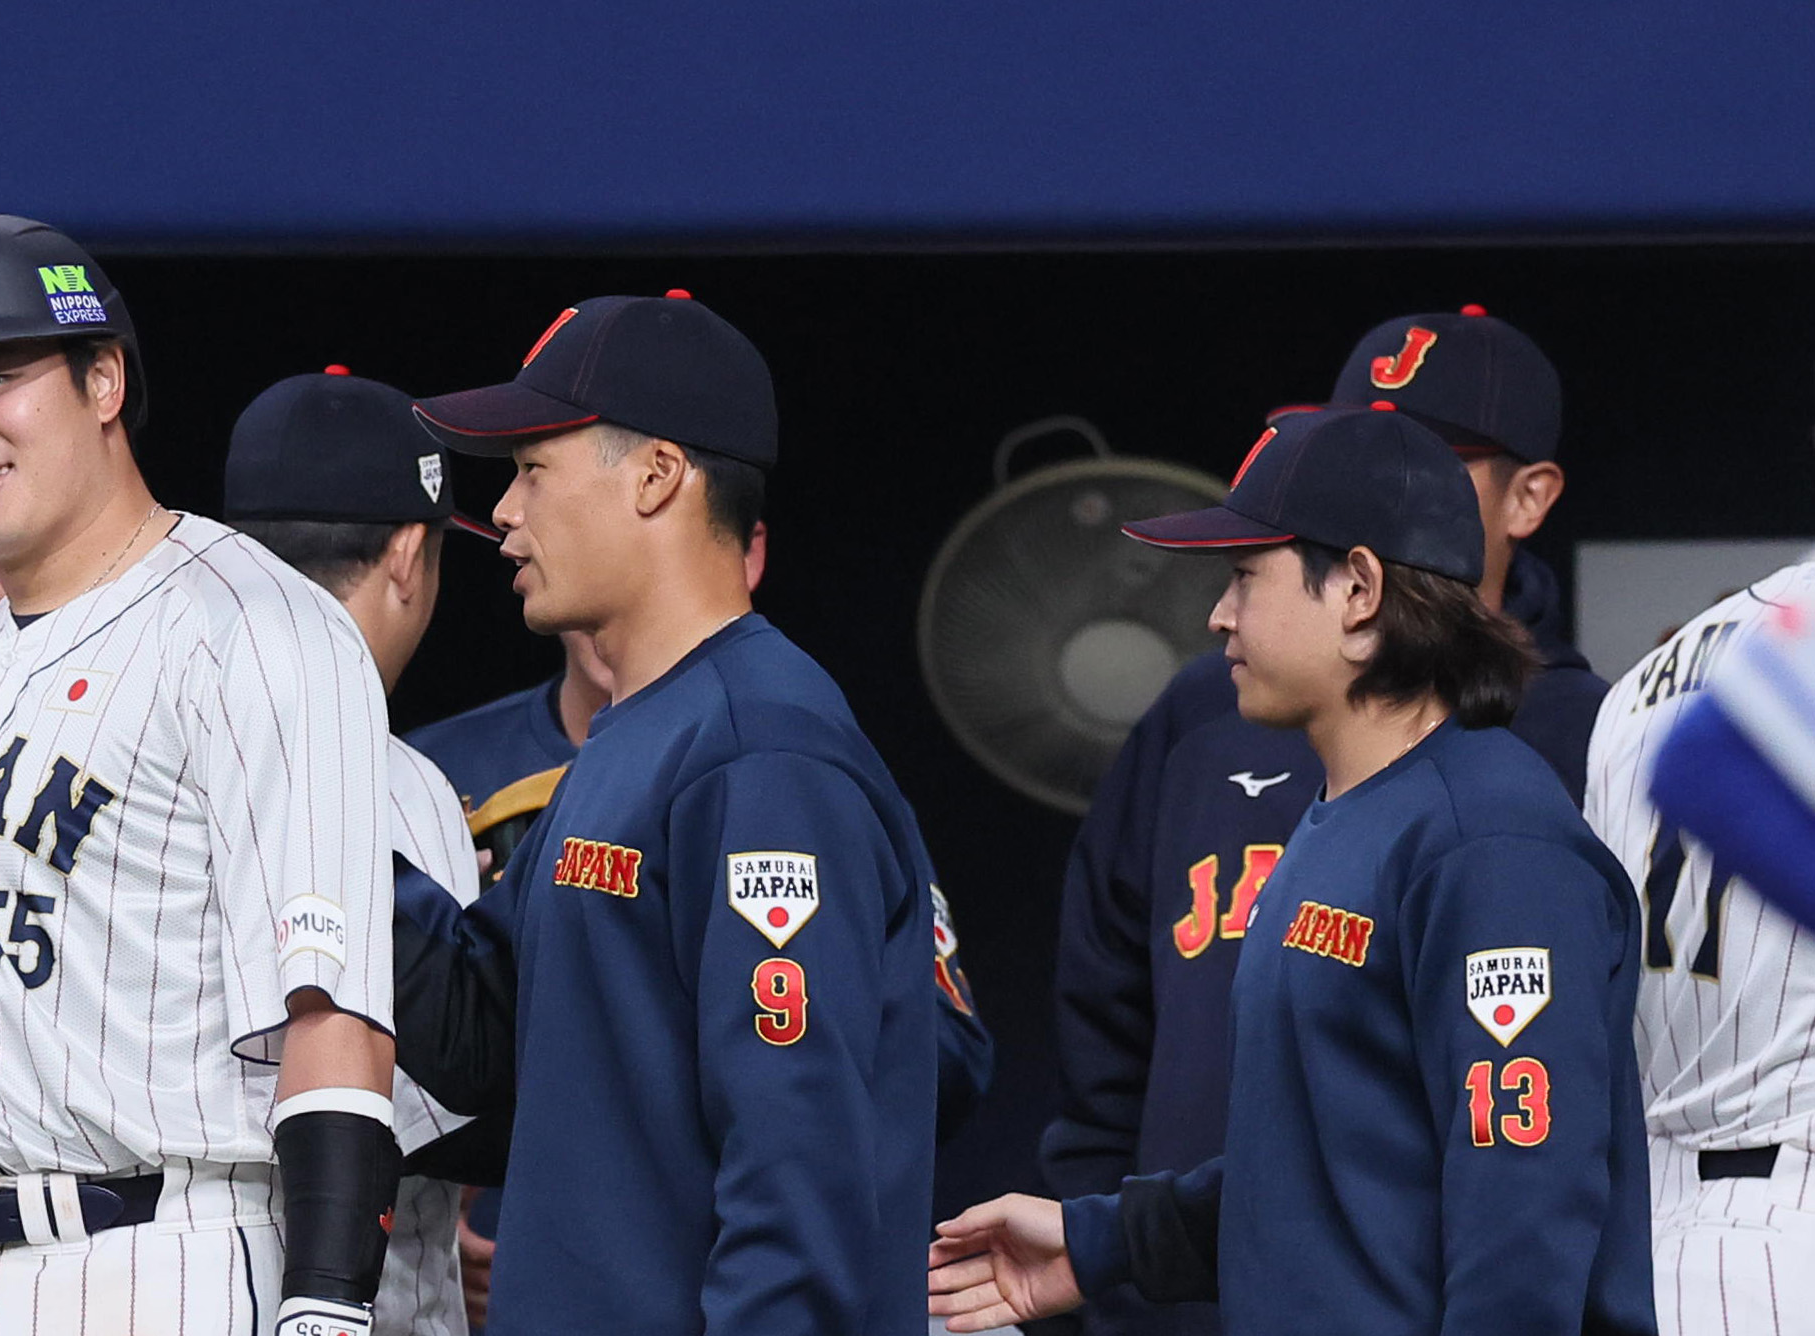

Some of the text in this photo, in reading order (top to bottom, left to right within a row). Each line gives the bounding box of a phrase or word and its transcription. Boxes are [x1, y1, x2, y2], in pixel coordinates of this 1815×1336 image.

[50, 294, 102, 312] NIPPON
[54, 308, 107, 325] EXPRESS
[1371, 327, 1438, 389] J
[554, 837, 643, 898] JAPAN
[735, 860, 813, 875] SAMURAI
[736, 876, 816, 900] JAPAN
[291, 911, 345, 945] MUFG
[1469, 957, 1545, 976] SAMURAI
[1470, 973, 1546, 1000] JAPAN
[750, 957, 809, 1046] 9
[1465, 1056, 1552, 1147] 13
